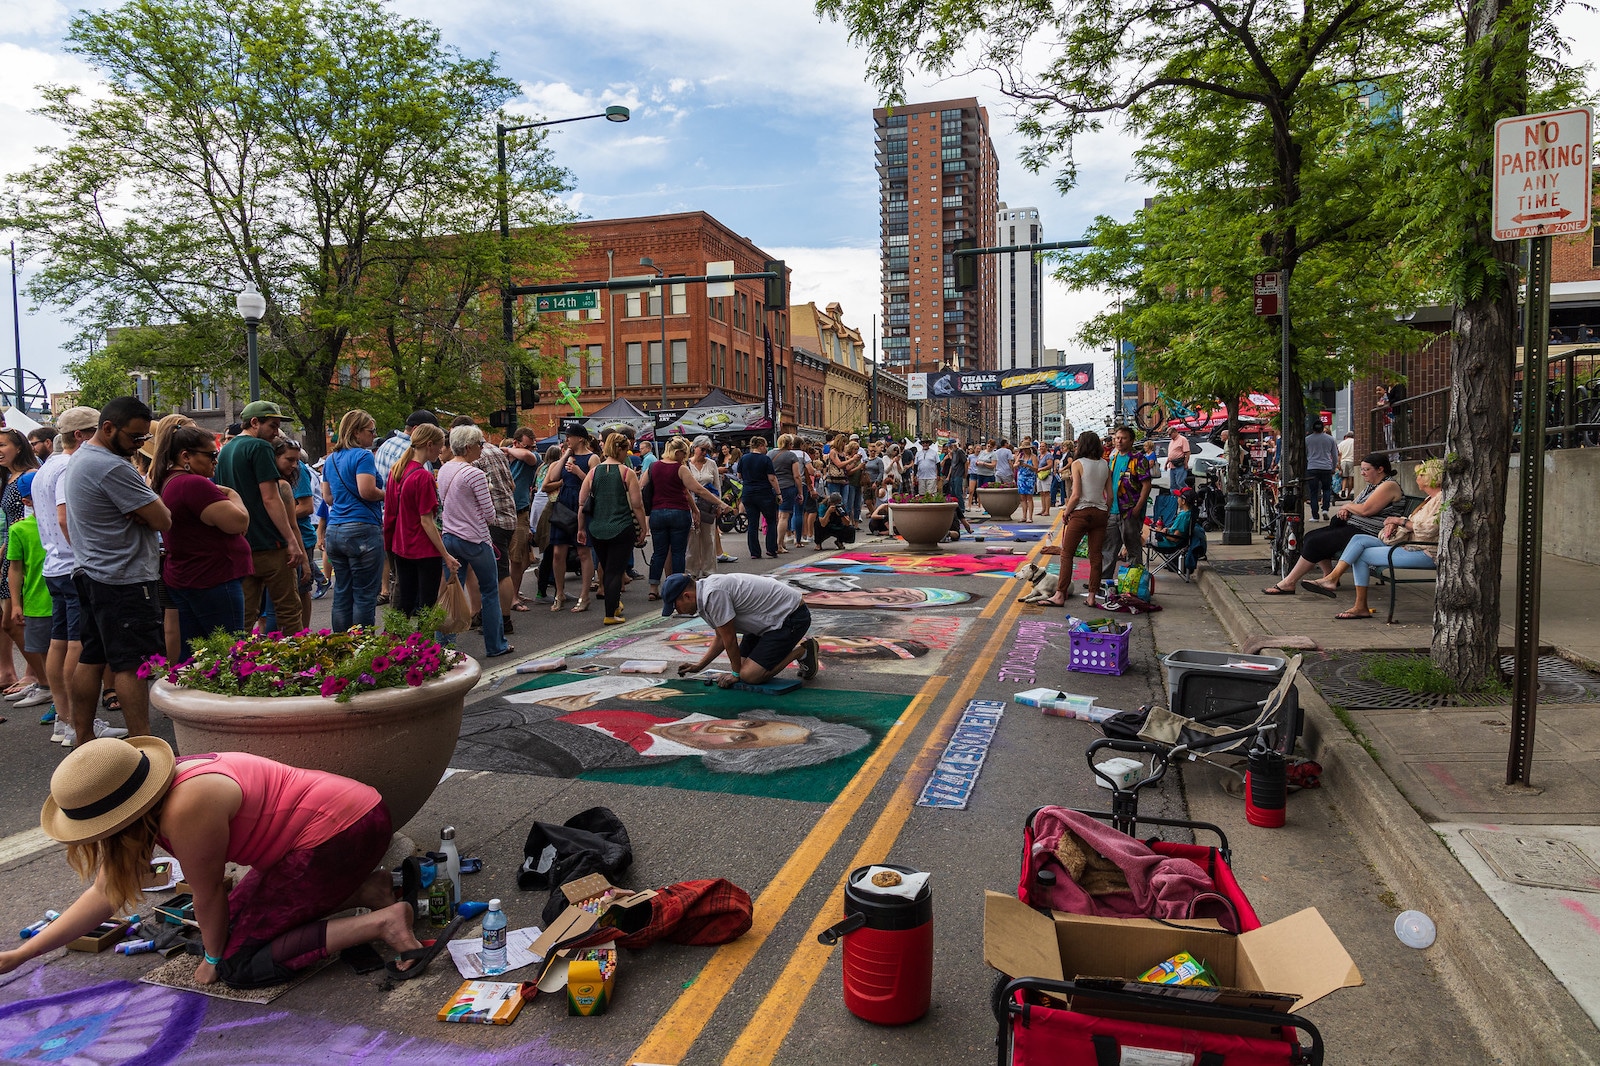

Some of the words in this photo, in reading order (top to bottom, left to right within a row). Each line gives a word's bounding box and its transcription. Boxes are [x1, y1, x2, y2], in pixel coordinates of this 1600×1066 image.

[1524, 121, 1560, 147] NO
[1501, 143, 1583, 176] PARKING
[1523, 173, 1560, 192] ANY
[1517, 191, 1561, 211] TIME
[1500, 228, 1520, 239] TOW
[1524, 224, 1551, 236] AWAY
[1555, 221, 1582, 232] ZONE
[553, 296, 577, 309] 14th
[960, 375, 997, 384] CHALK
[960, 383, 983, 391] ART
[964, 700, 1004, 725] BLUE
[919, 761, 981, 807] PIZZA
